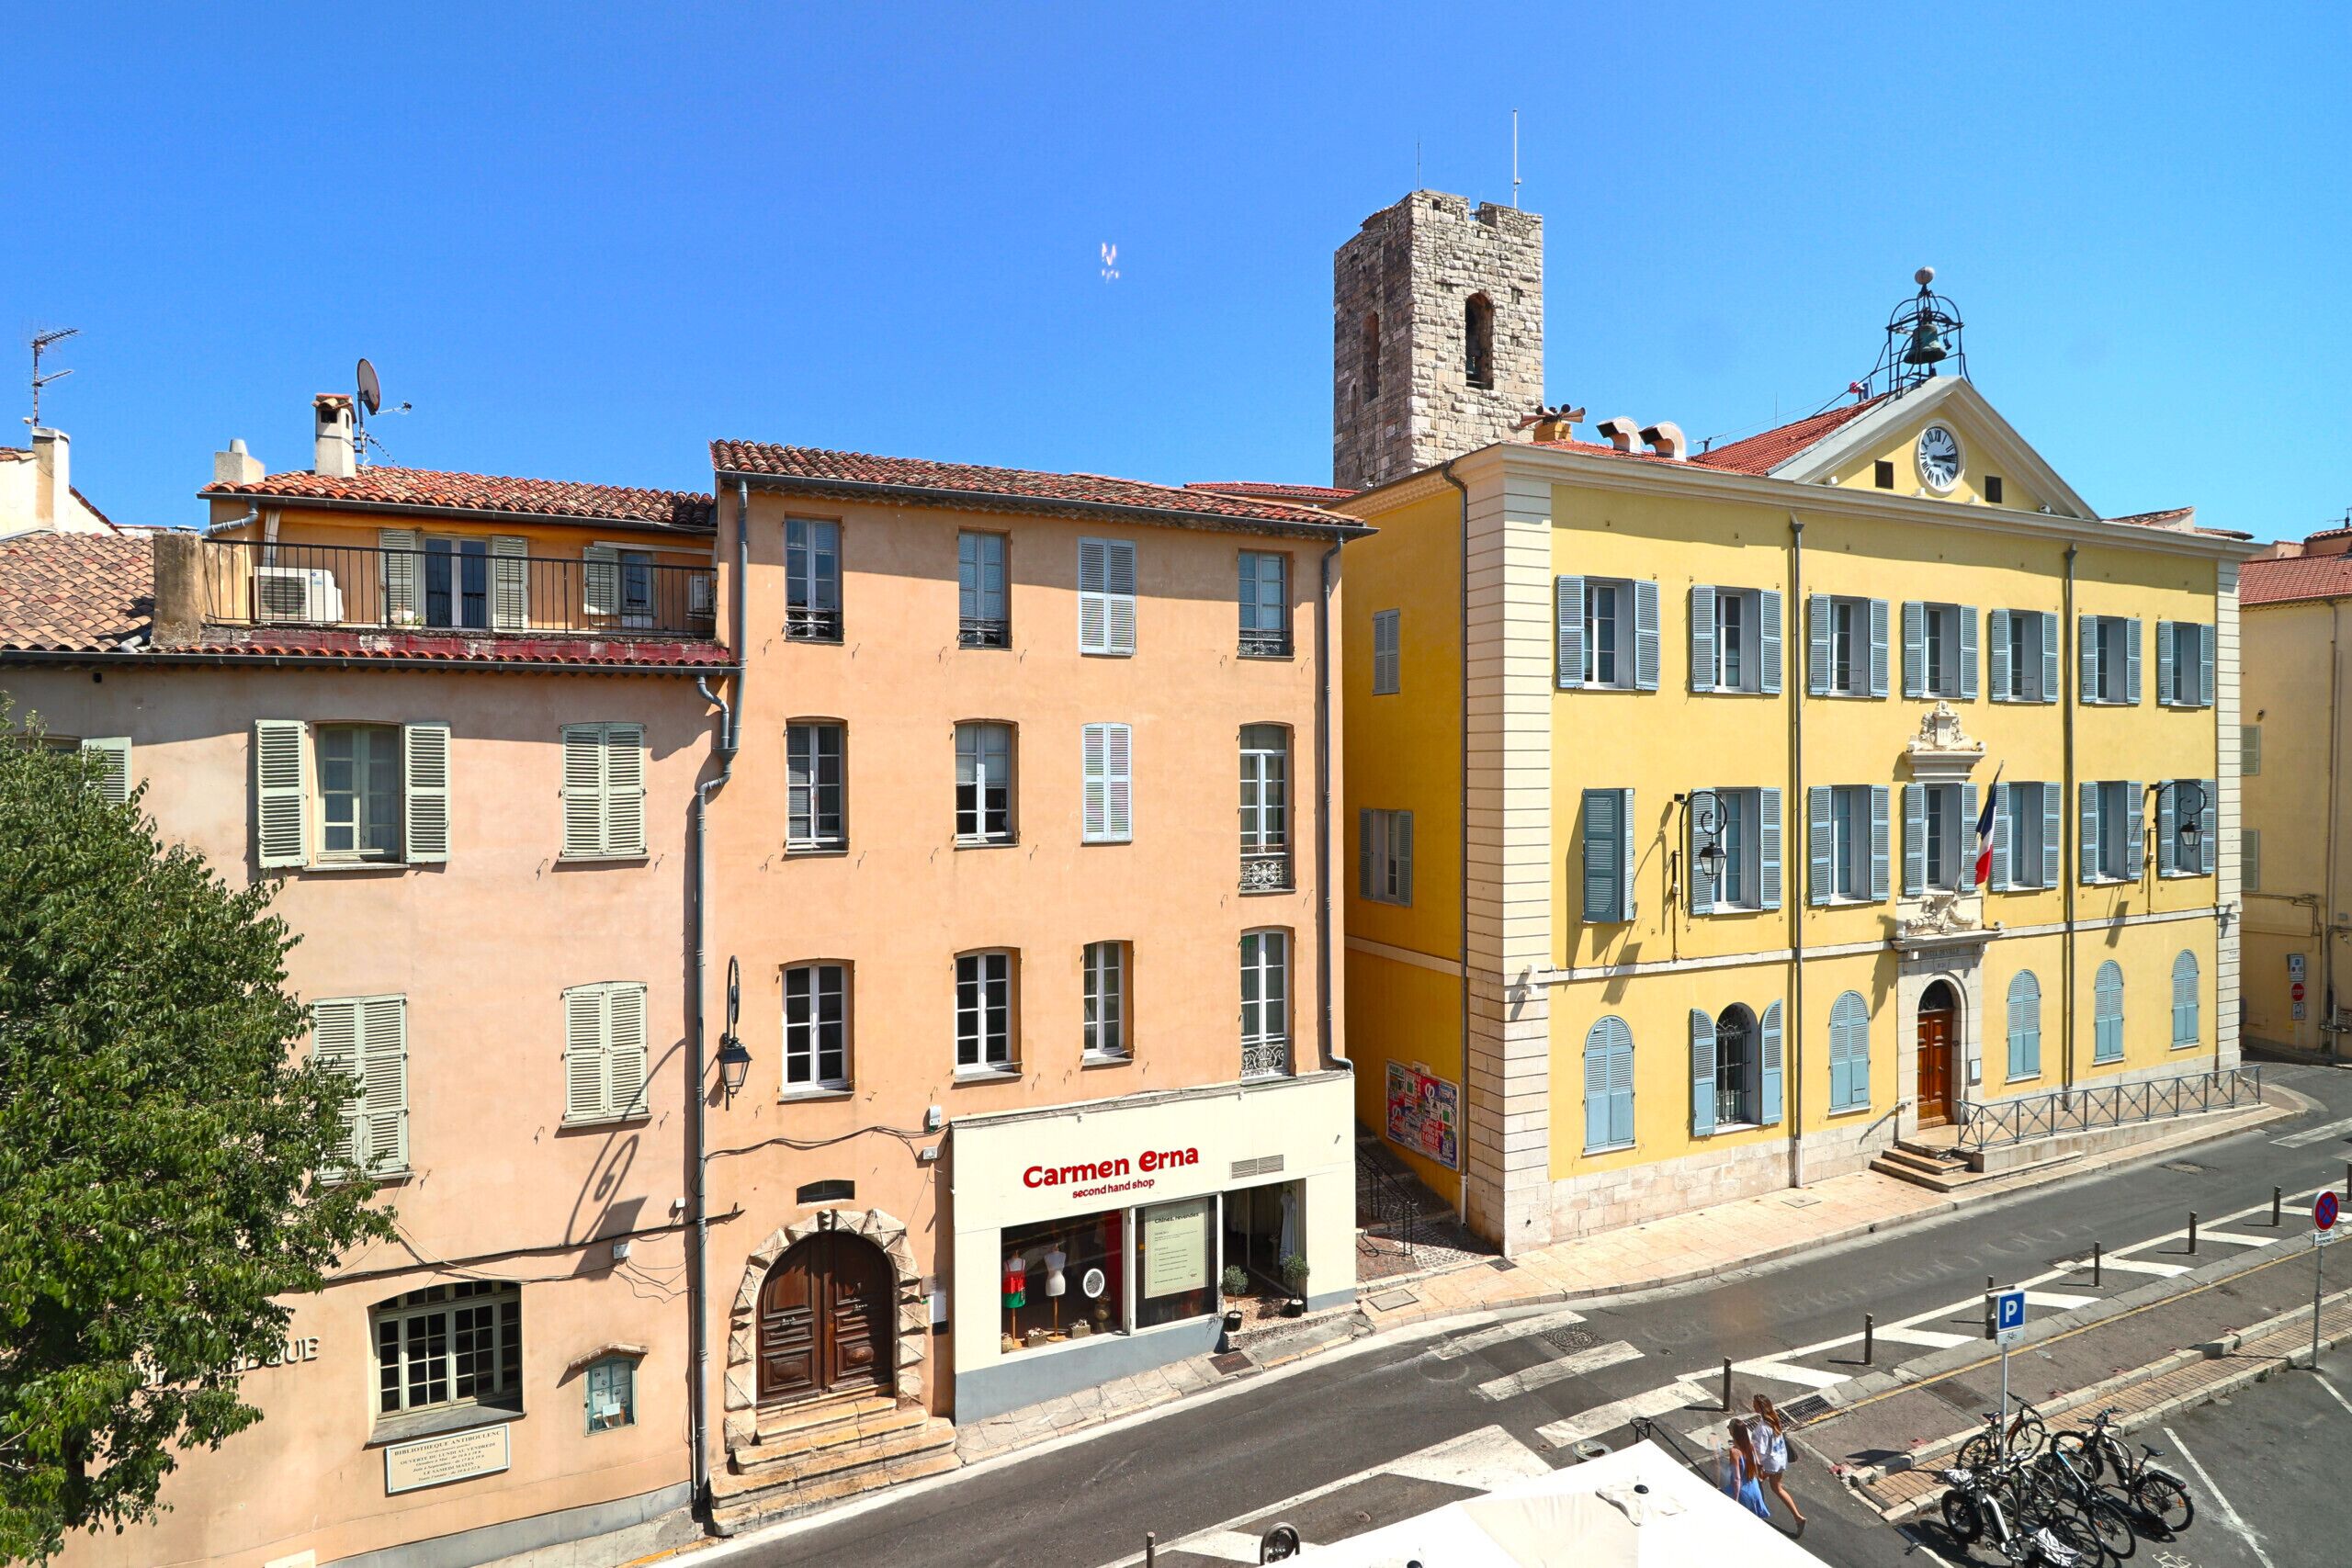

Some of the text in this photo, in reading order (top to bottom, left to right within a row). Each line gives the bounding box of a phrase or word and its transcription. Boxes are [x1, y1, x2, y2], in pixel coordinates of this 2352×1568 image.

[1023, 1158, 1130, 1189] Carmen
[1072, 1178, 1155, 1199] second hand shop
[2006, 1300, 2018, 1323] P
